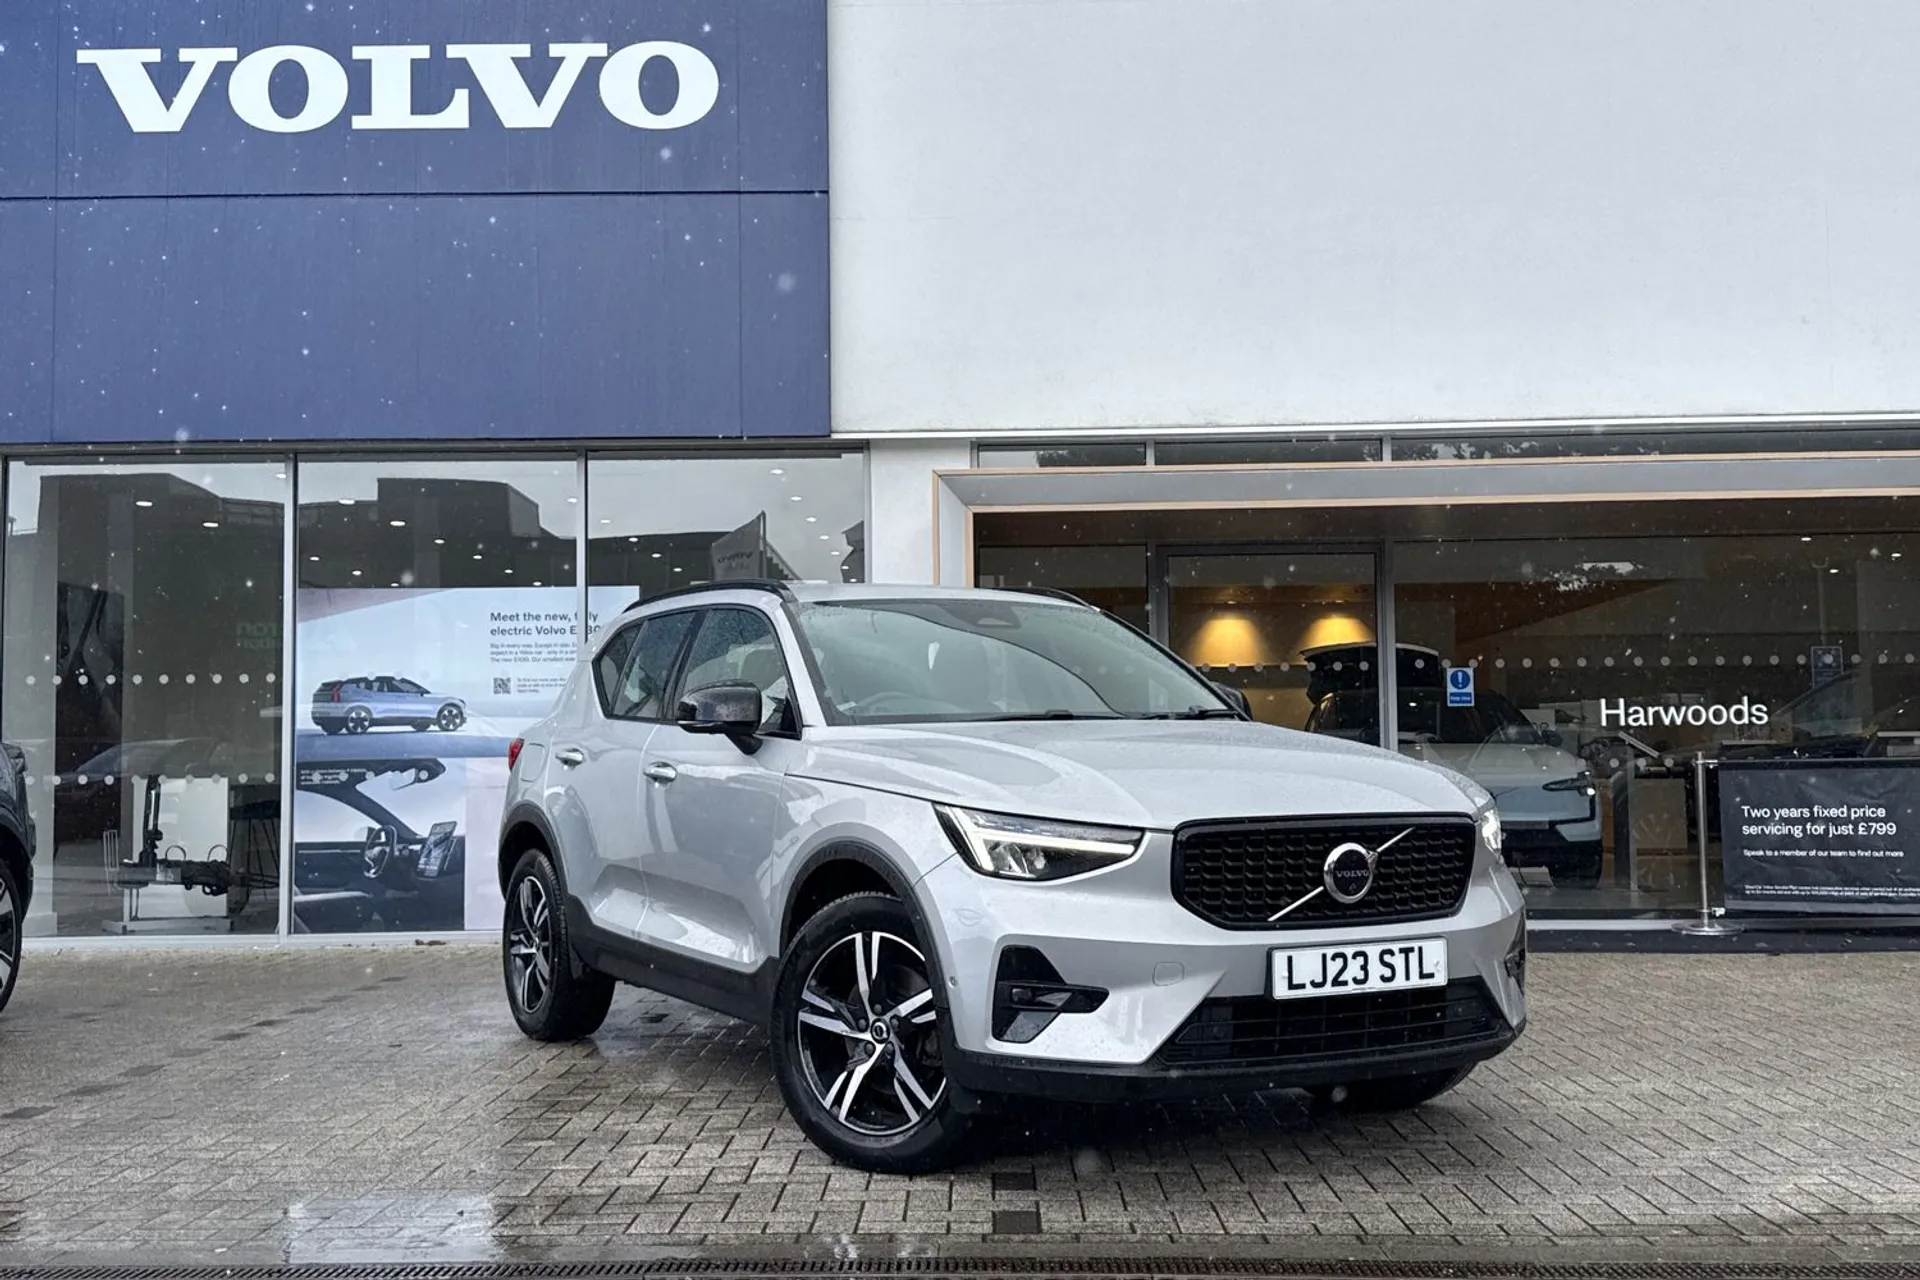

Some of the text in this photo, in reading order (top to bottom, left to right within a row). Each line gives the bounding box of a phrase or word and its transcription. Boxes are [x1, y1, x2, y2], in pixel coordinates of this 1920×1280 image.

[76, 40, 719, 133] VOLVO
[490, 612, 598, 623] Meet the new, fly
[490, 625, 601, 636] electric Volvo E30
[1600, 695, 1769, 727] Harwoods
[1741, 805, 1886, 820] Two years fixed price
[1742, 822, 1896, 838] servicing for just £799
[1765, 849, 1773, 857] to
[1808, 849, 1817, 857] of
[1849, 850, 1857, 858] to
[1857, 849, 1871, 858] find
[1872, 850, 1884, 858] out
[1335, 869, 1370, 878] VOLVO
[1287, 946, 1435, 991] LJ23 STL
